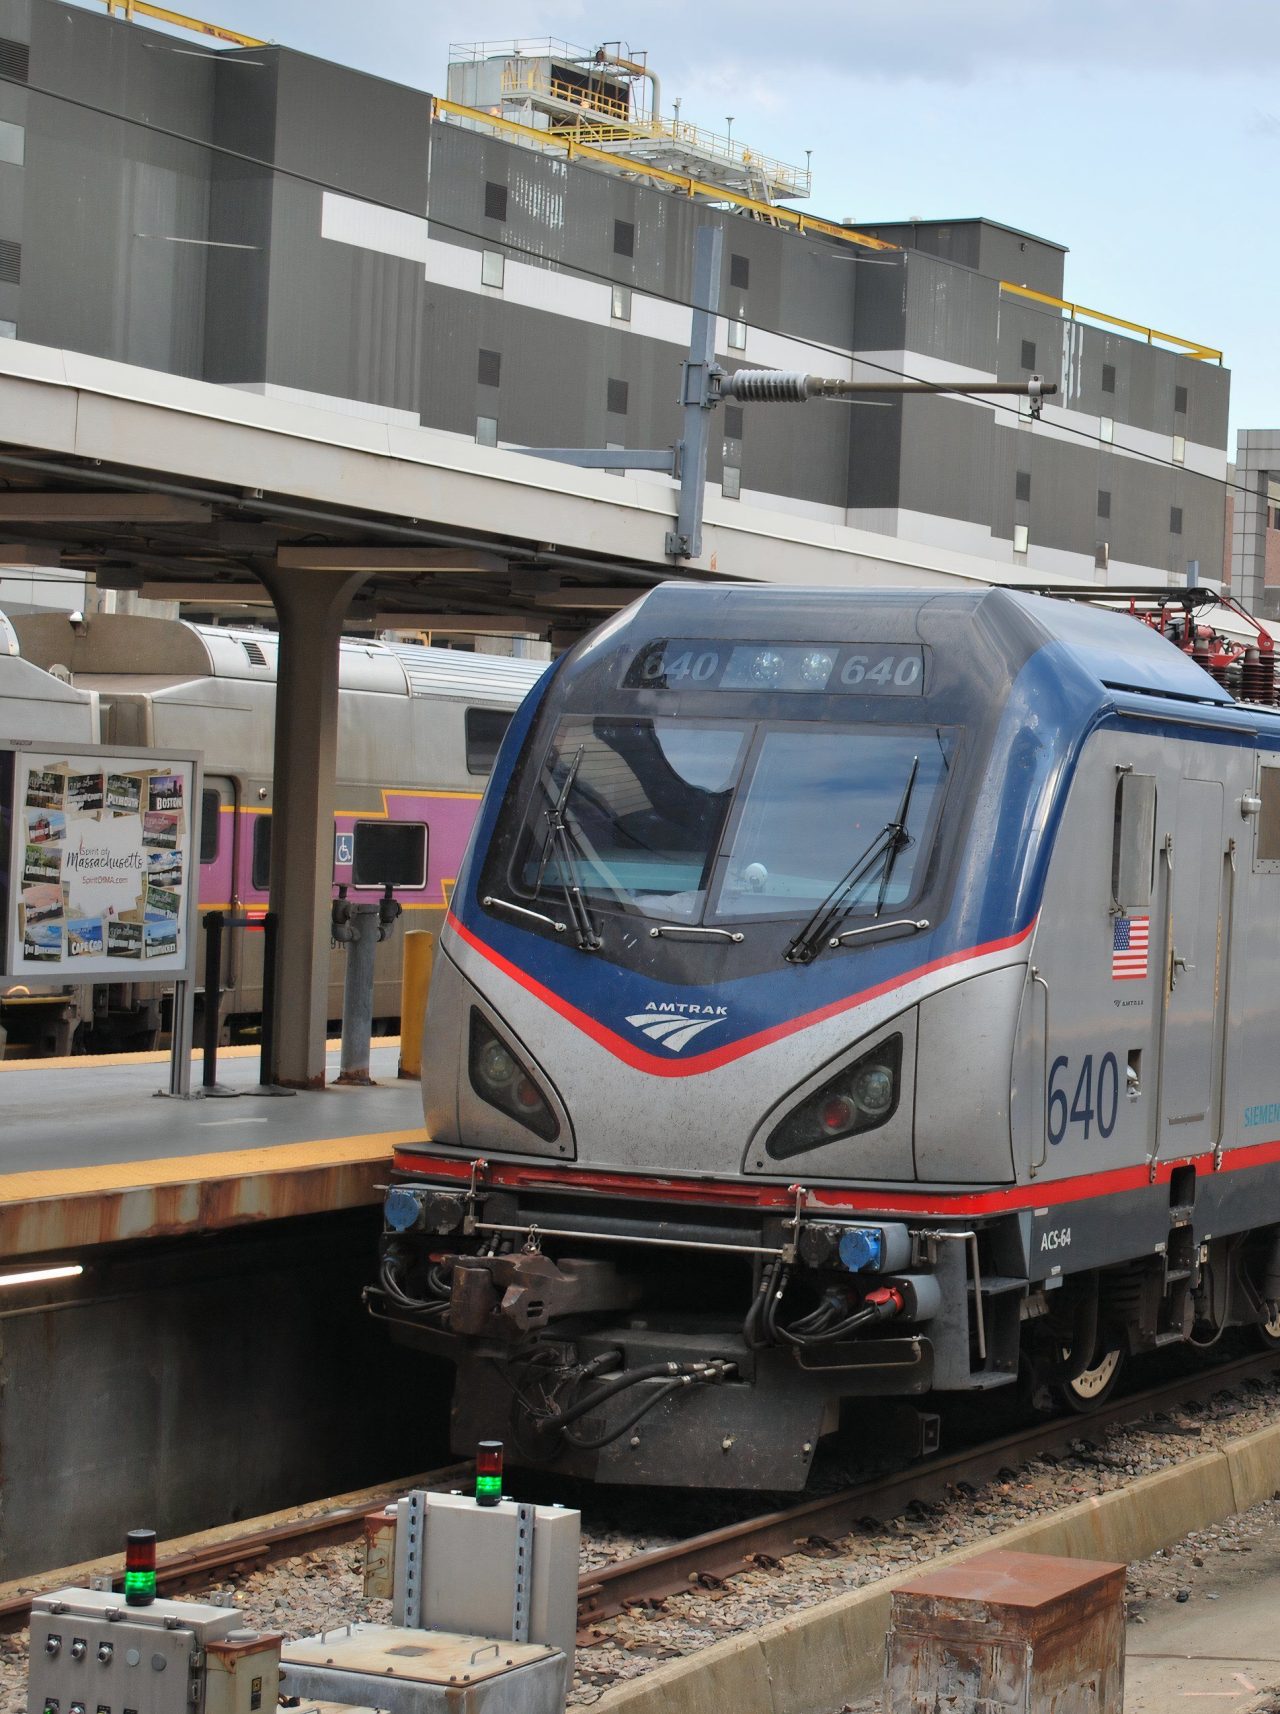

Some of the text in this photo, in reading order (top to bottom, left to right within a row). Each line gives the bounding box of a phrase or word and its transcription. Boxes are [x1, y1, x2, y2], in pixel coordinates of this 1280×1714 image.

[640, 651, 719, 681] 640
[840, 655, 922, 686] 640
[156, 797, 184, 810] BOSTON
[66, 851, 144, 872] Massachusetts
[645, 1001, 728, 1015] AMTRAK
[1047, 1051, 1119, 1146] 640
[1040, 1227, 1072, 1252] ACS-64
